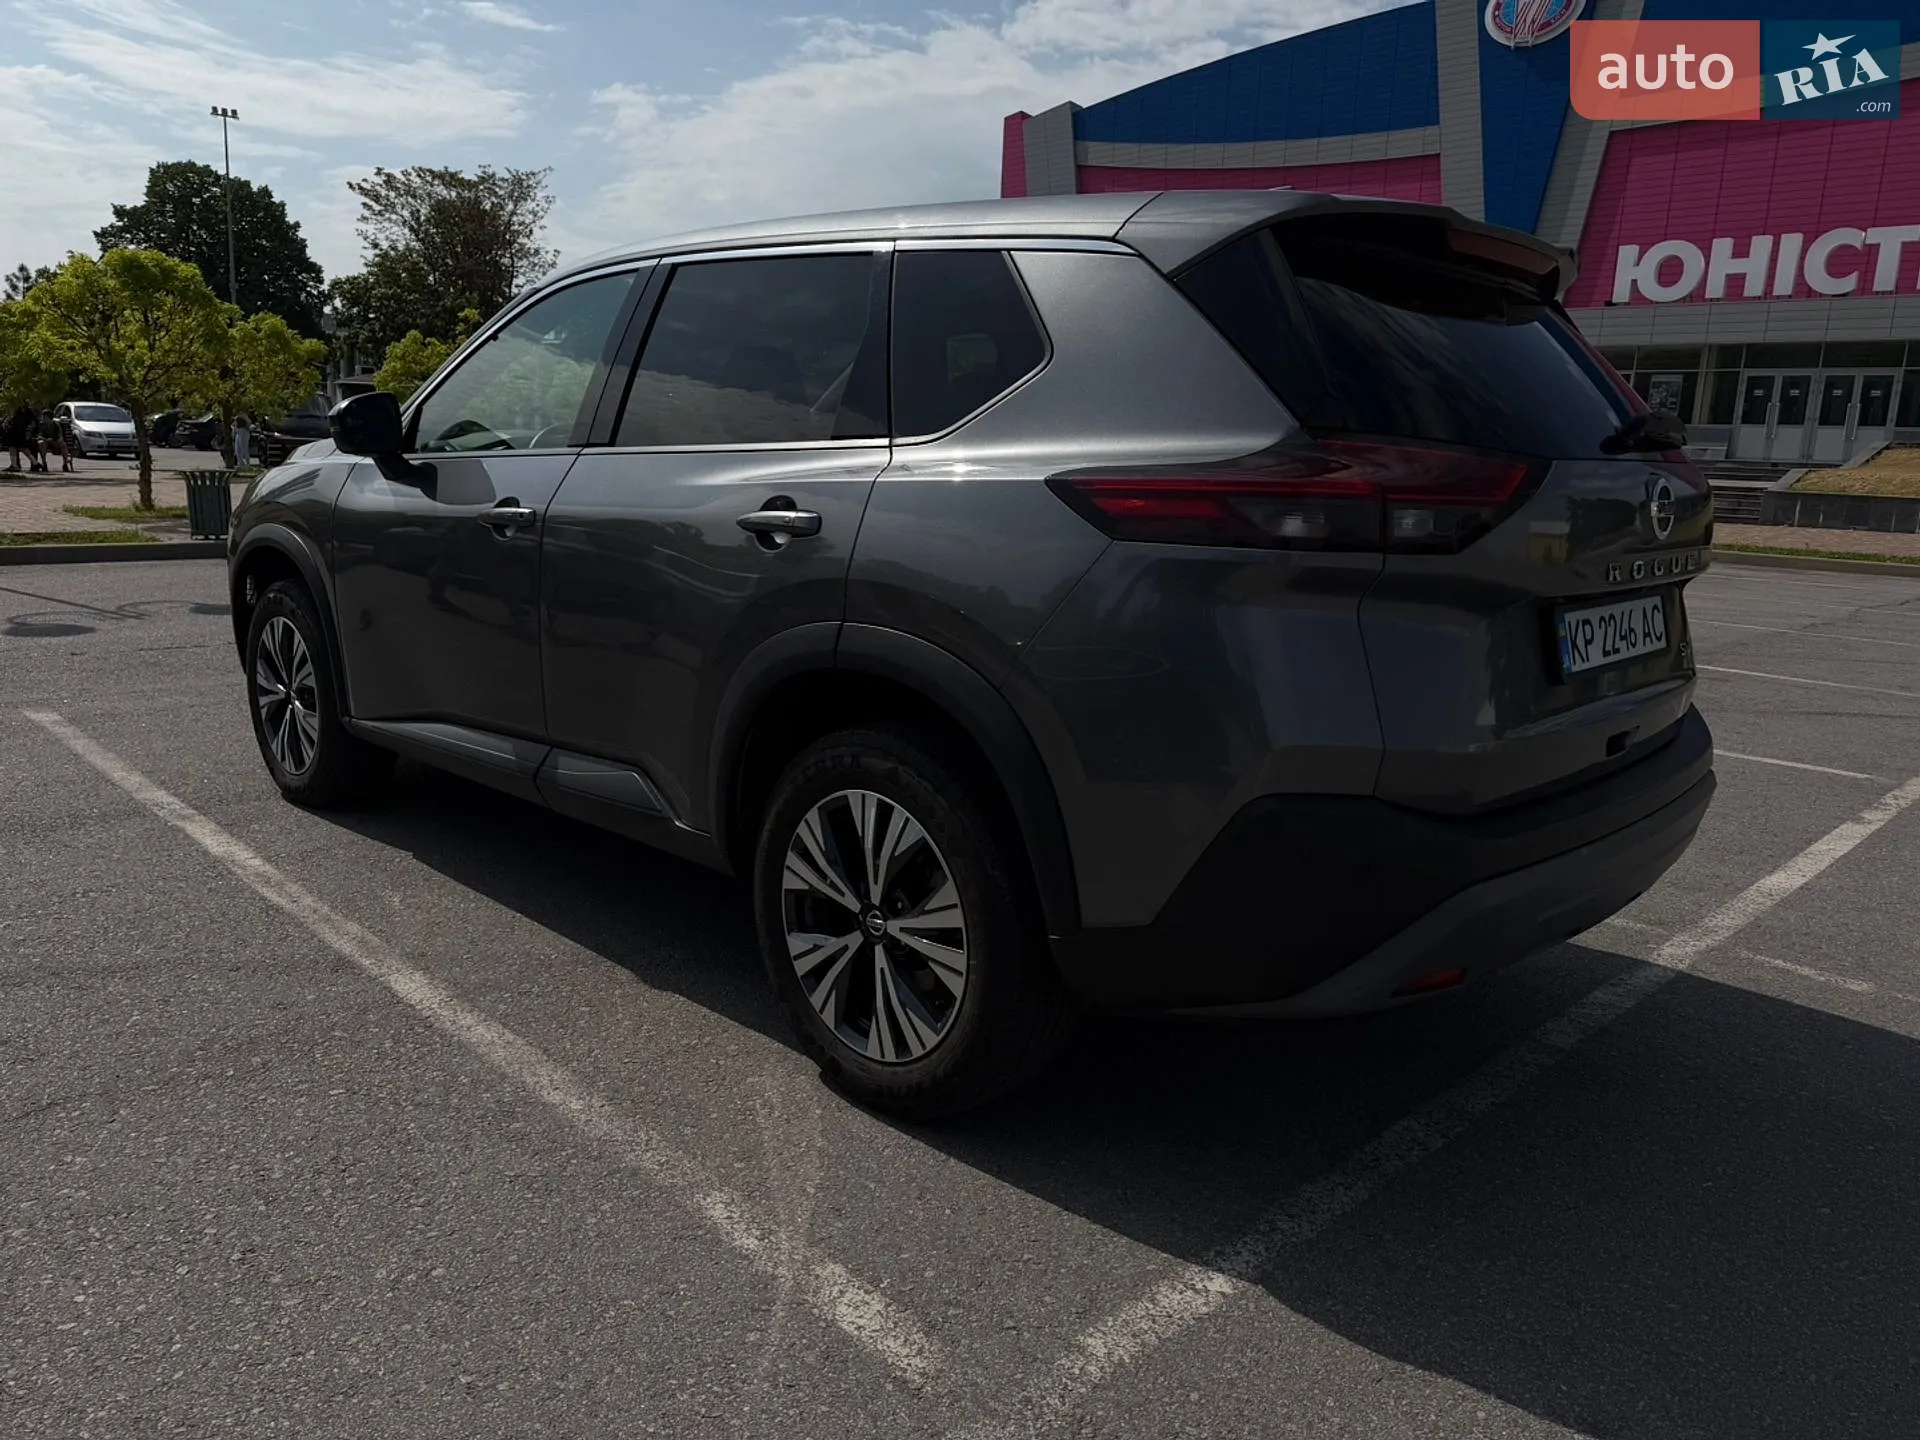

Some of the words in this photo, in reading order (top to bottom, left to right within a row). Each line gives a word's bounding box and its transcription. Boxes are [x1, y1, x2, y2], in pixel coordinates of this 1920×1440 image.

[1612, 225, 1920, 303] ЮНІСТ
[1608, 552, 1697, 582] ROGUE
[1568, 618, 1595, 666] KP
[1599, 608, 1638, 658] 2246
[1642, 604, 1664, 647] AC
